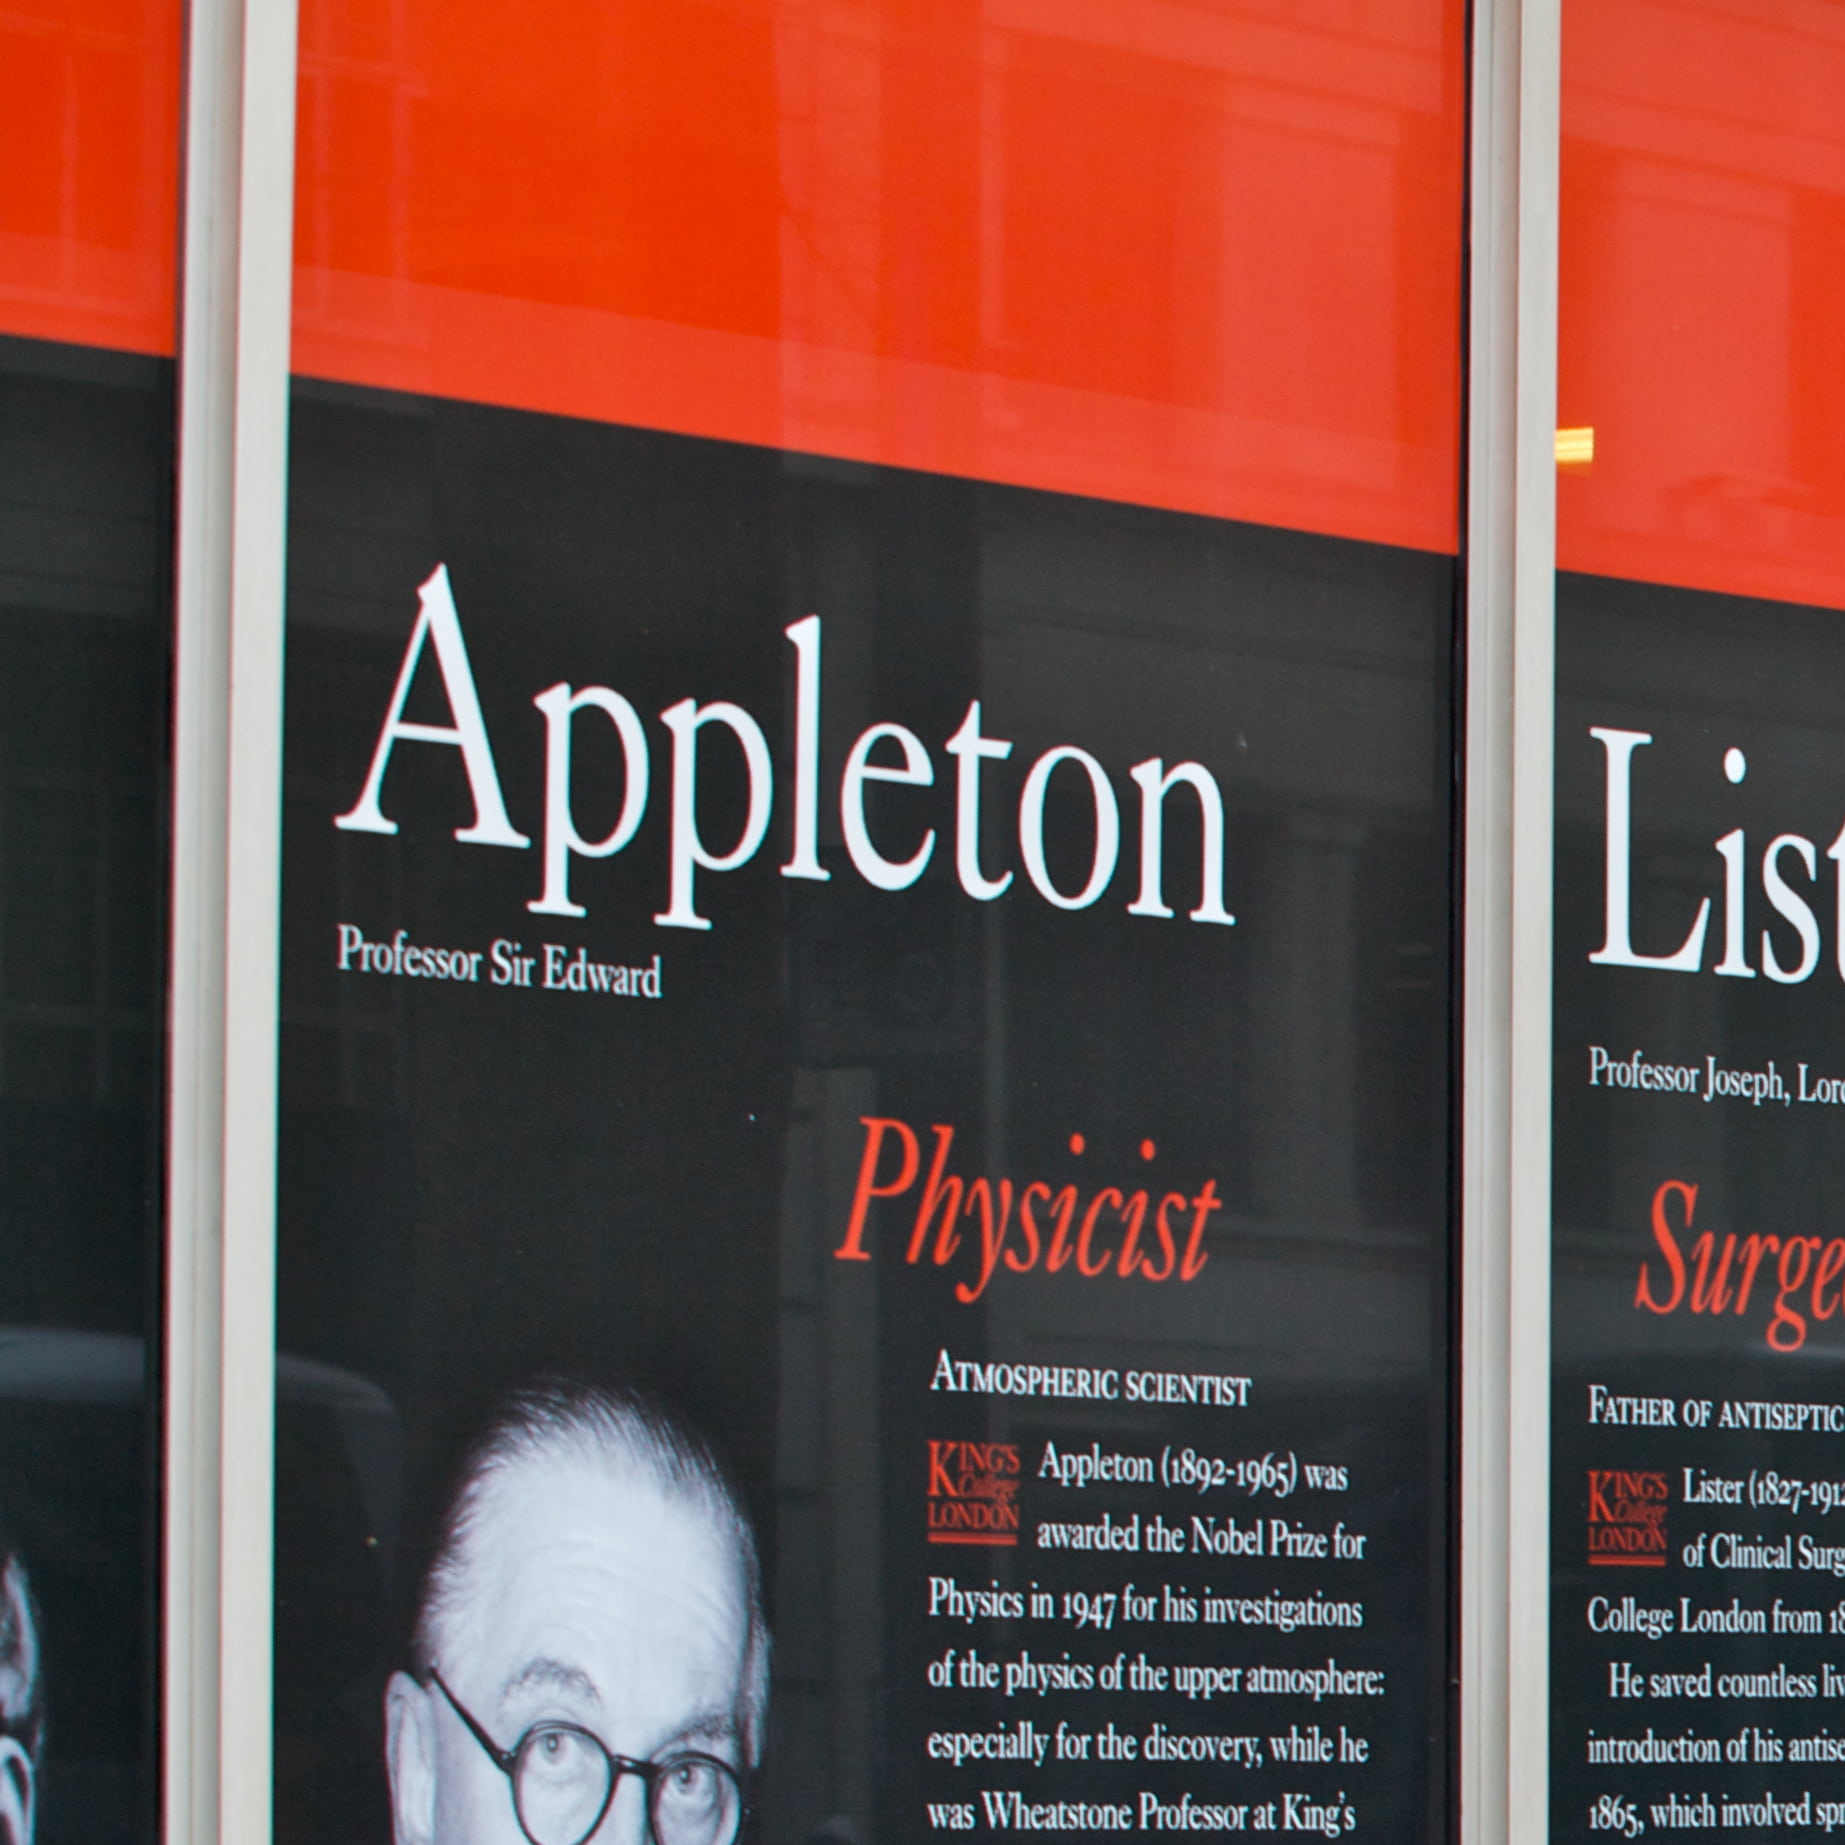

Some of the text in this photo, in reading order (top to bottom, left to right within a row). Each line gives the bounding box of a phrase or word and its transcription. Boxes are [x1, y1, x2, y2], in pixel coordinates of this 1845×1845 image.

[335, 564, 1234, 930] Appleton
[339, 925, 660, 997] Professor Sir Edward
[1590, 1047, 1699, 1092] Professor
[1703, 1056, 1790, 1105] Joseph,
[834, 1117, 1221, 1303] Physicist
[1038, 1441, 1347, 1497] Appleton (1892-1965) was
[1683, 1468, 1744, 1503] Lister
[928, 1502, 1018, 1528] LONDON
[1038, 1513, 1365, 1558] awarded the Nobel Prize for
[1589, 1526, 1665, 1551] LONDON
[1683, 1533, 1706, 1567] of
[1711, 1533, 1791, 1569] Clinical
[929, 1577, 1362, 1632] Physics in 1947 for his investigations
[1588, 1596, 1673, 1639] College
[1680, 1598, 1765, 1632] London
[1772, 1599, 1821, 1633] from
[928, 1649, 1383, 1701] of the physics of the upper atmosphere:
[1610, 1662, 1643, 1697] He
[1650, 1663, 1711, 1697] saved
[1717, 1663, 1816, 1697] countless
[928, 1721, 1367, 1768] especially for the discovery, while he
[1588, 1728, 1720, 1763] introduction
[1726, 1727, 1749, 1762] of
[1753, 1727, 1783, 1762] his
[928, 1804, 973, 1829] was
[982, 1791, 1131, 1829] Wheatstone
[1140, 1792, 1247, 1830] Professor
[1254, 1802, 1275, 1830] at
[1590, 1795, 1643, 1837] 1865,
[1650, 1793, 1715, 1827] which
[1722, 1792, 1810, 1826] involved
